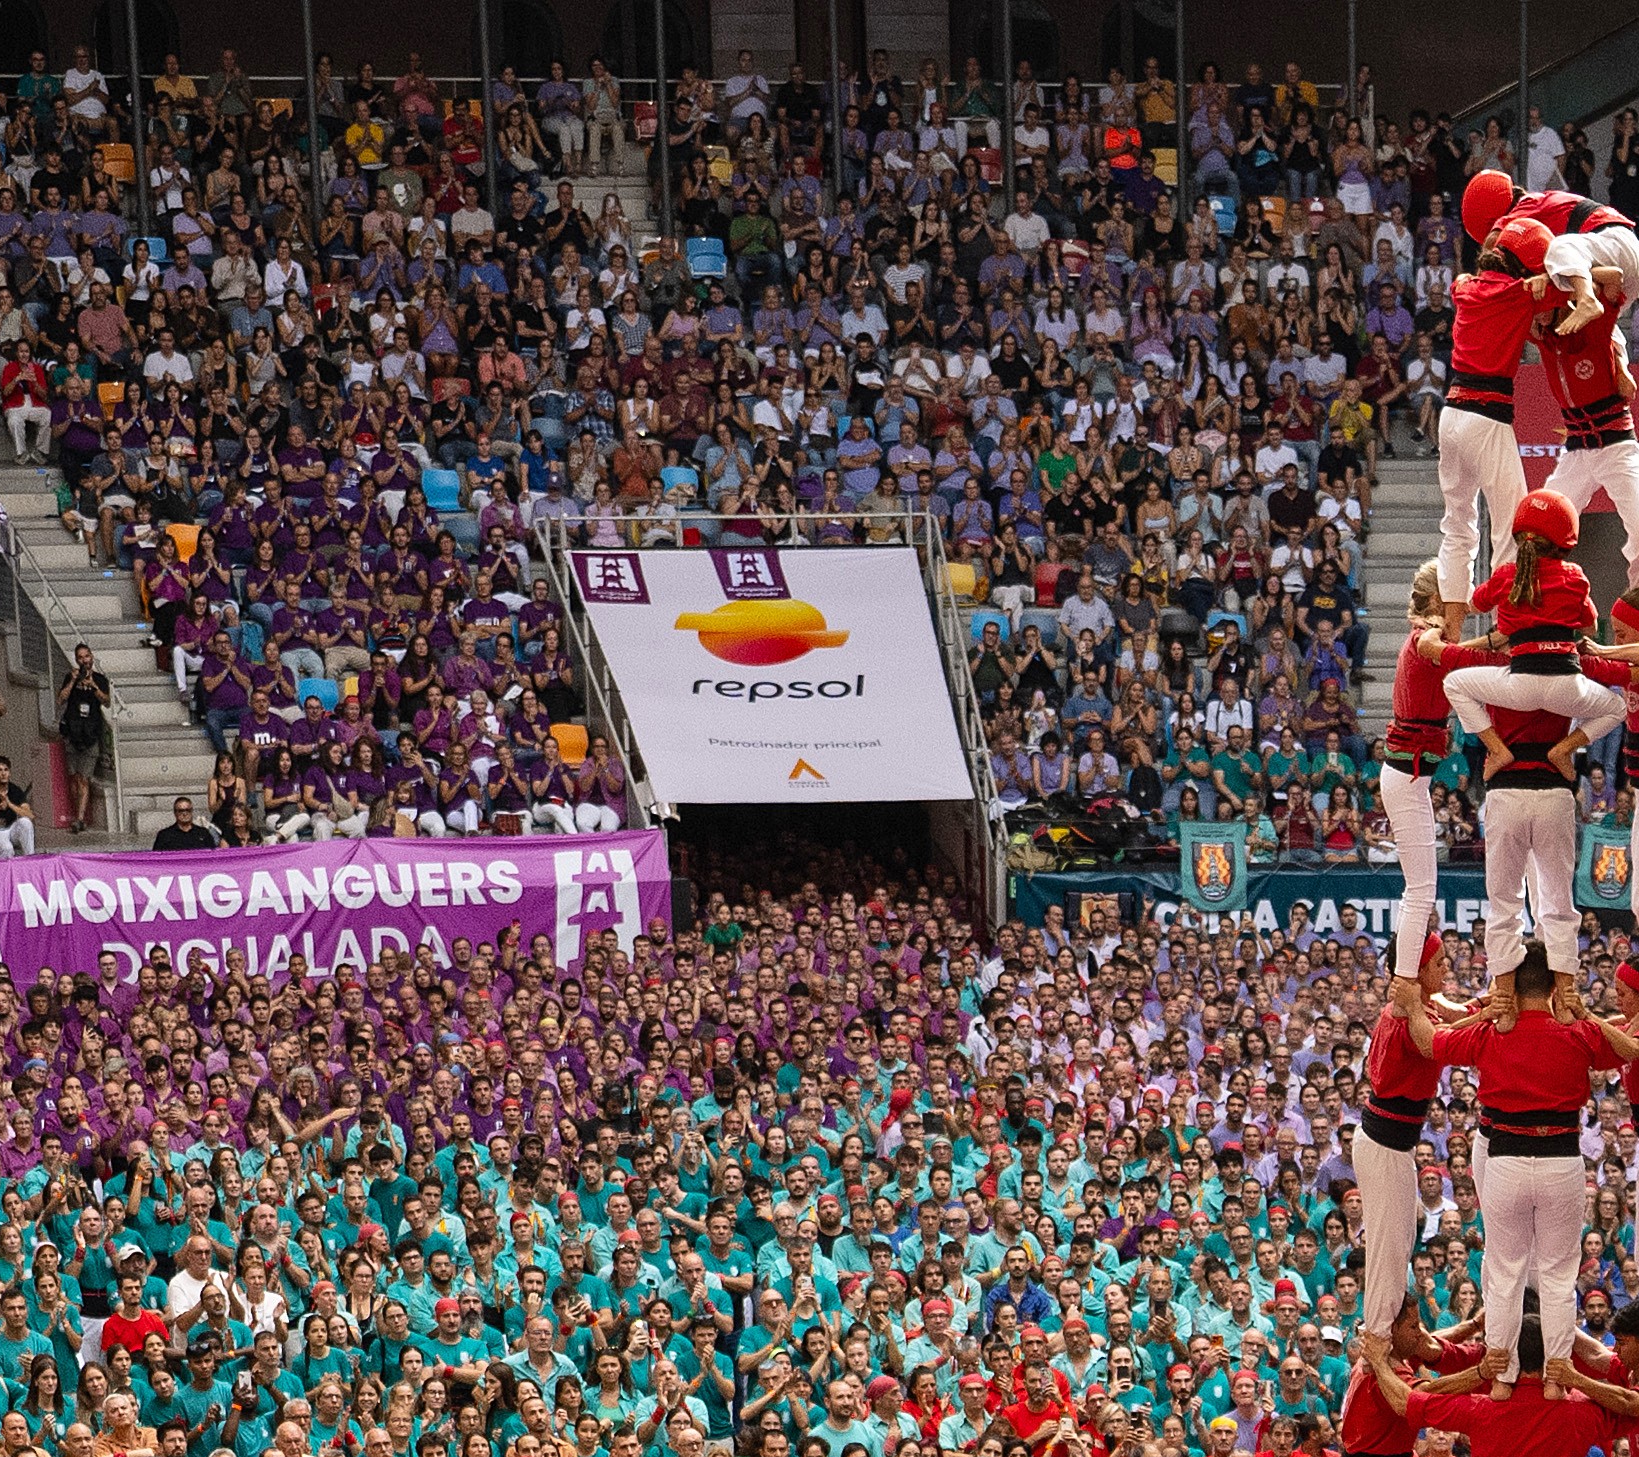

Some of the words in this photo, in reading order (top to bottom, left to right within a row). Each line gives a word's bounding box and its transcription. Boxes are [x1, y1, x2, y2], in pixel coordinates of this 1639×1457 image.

[692, 674, 865, 703] repsol
[708, 737, 809, 750] Patrocinador
[813, 738, 881, 751] principal
[16, 860, 523, 929] MOIXIGANGUERS
